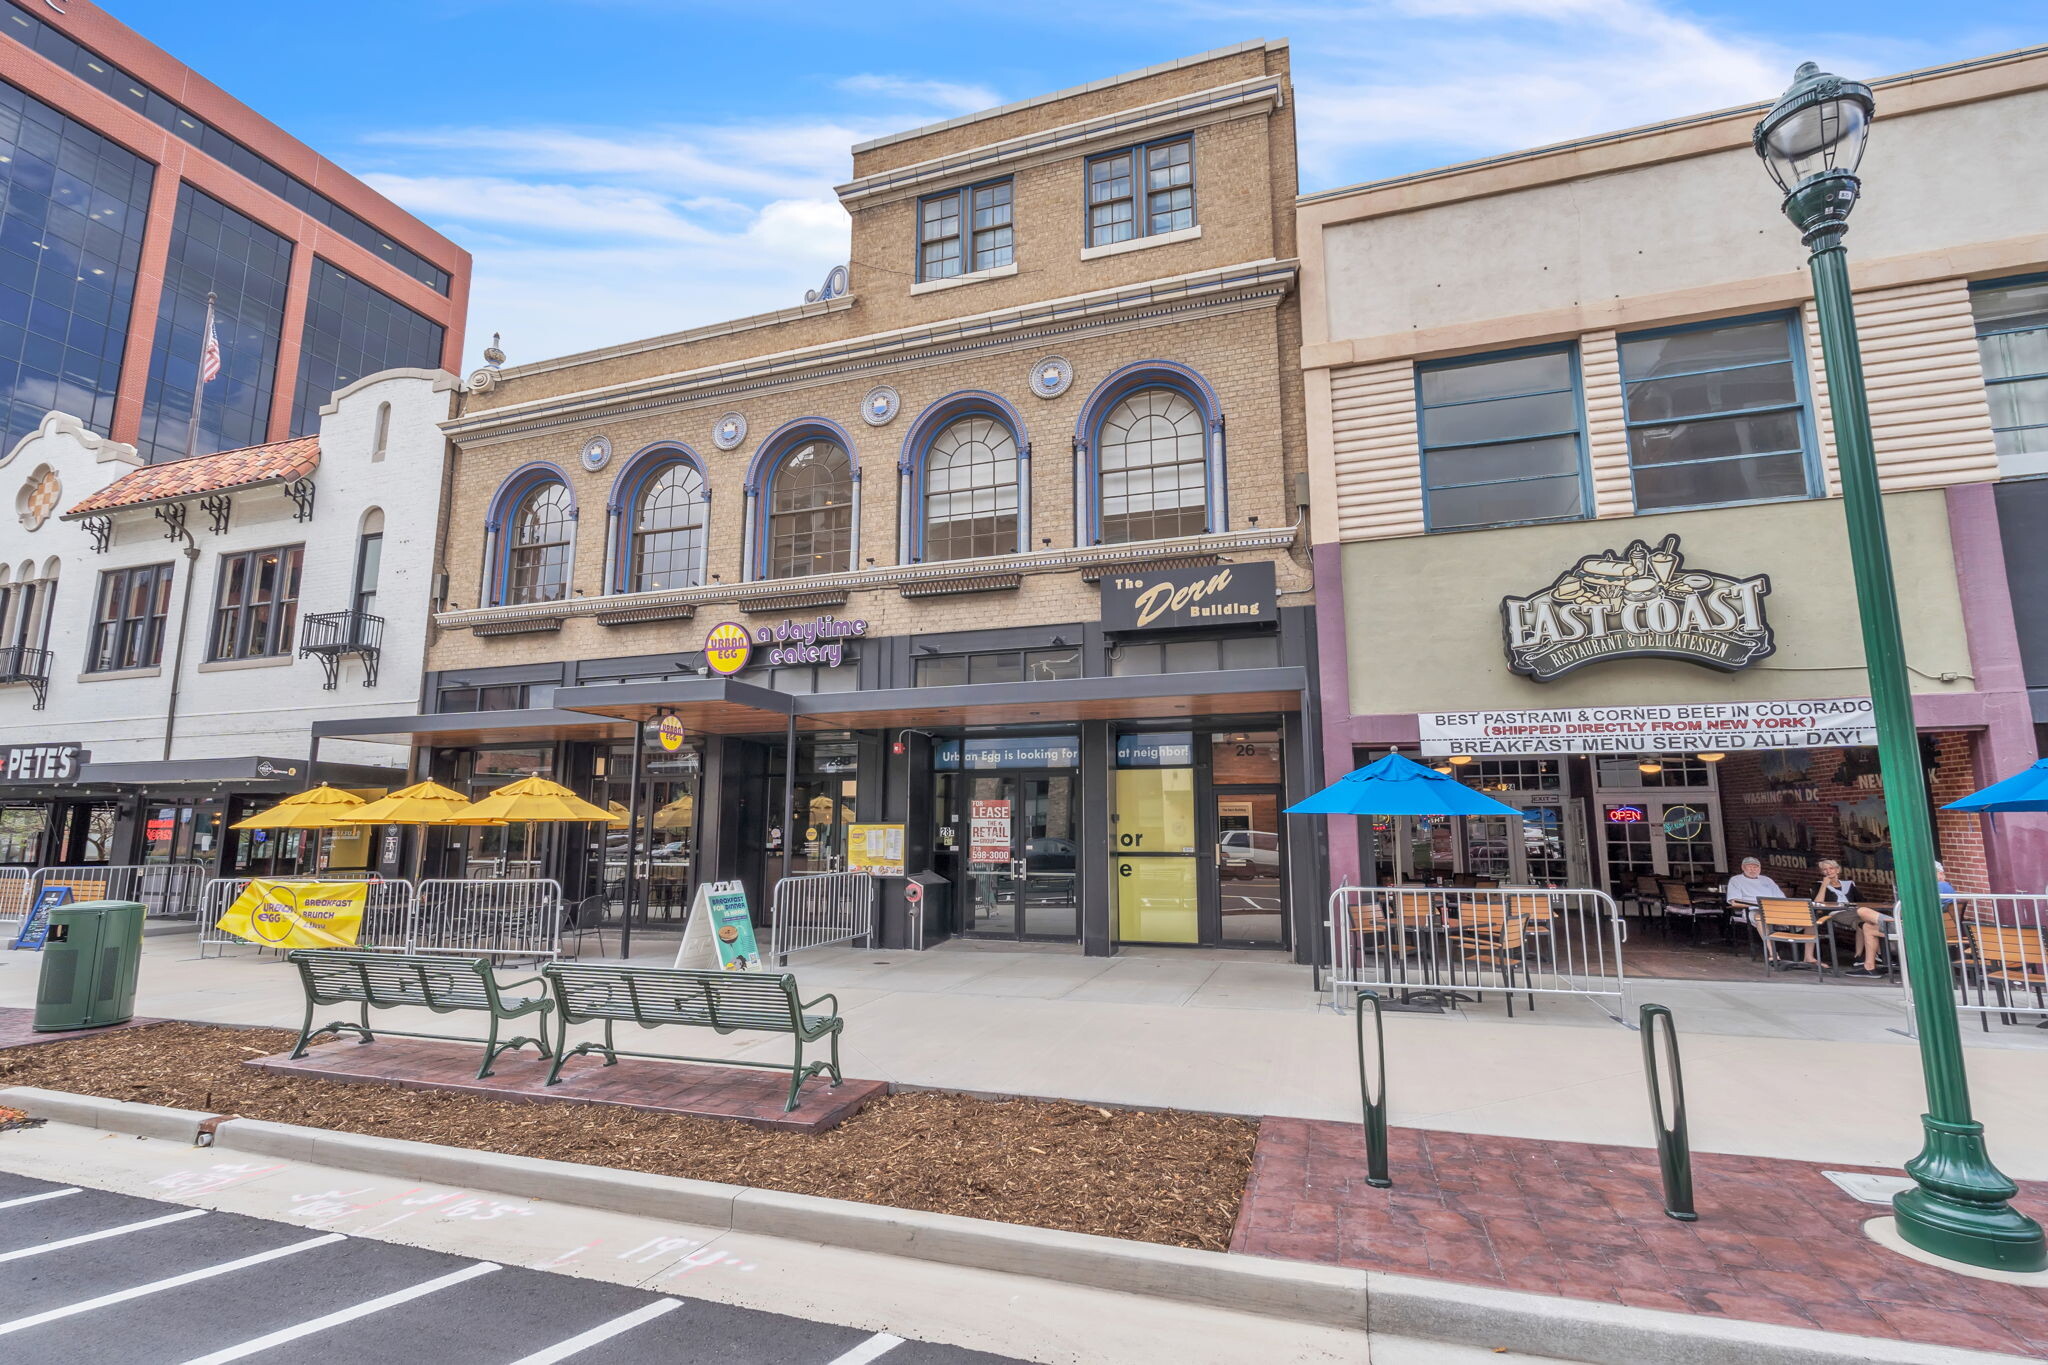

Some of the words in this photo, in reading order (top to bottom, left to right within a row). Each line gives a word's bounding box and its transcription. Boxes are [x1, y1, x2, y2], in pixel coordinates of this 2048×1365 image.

[1115, 578, 1144, 590] The
[1135, 568, 1233, 627] Dern
[1190, 602, 1260, 618] Building
[1506, 600, 1615, 650] EAST
[1621, 578, 1766, 637] COAST
[756, 626, 771, 642] a
[775, 614, 867, 646] daytime
[710, 636, 745, 649] URBAN
[1549, 633, 1623, 668] RESTAURANT
[1627, 634, 1636, 648] &
[1640, 632, 1729, 658] DELICATESSEN
[717, 649, 738, 659] EGG
[769, 641, 842, 668] eatery
[1435, 713, 1478, 726] BEST
[1484, 711, 1572, 725] PASTRAMI
[1577, 710, 1590, 722] &
[1593, 707, 1671, 722] CORNED
[1677, 705, 1726, 719] BEEF
[1732, 704, 1750, 717] IN
[1756, 700, 1873, 716] COLORADO
[1565, 722, 1648, 734] DIRECTLY
[1652, 720, 1702, 732] FROM
[1707, 719, 1749, 731] NEW
[1450, 738, 1576, 754] BREAKFAST
[1582, 737, 1645, 752] MENU
[1652, 735, 1746, 750] SERVED
[1753, 733, 1799, 748] ALL
[1806, 730, 1862, 746] DAY!
[981, 750, 1001, 763] Egg
[1004, 750, 1014, 761] is
[1017, 748, 1058, 761] looking
[1062, 748, 1078, 759] for
[1133, 745, 1189, 760] neighbor!
[1236, 744, 1255, 757] 26
[7, 746, 73, 780] PETE'S
[1805, 787, 1820, 802] DC
[972, 806, 1009, 818] LEASE
[1610, 810, 1641, 821] OPEN
[972, 826, 1009, 838] RETAIL
[1120, 833, 1143, 847] or
[972, 851, 1009, 859] 598-3000
[1769, 854, 1807, 869] BOSTON
